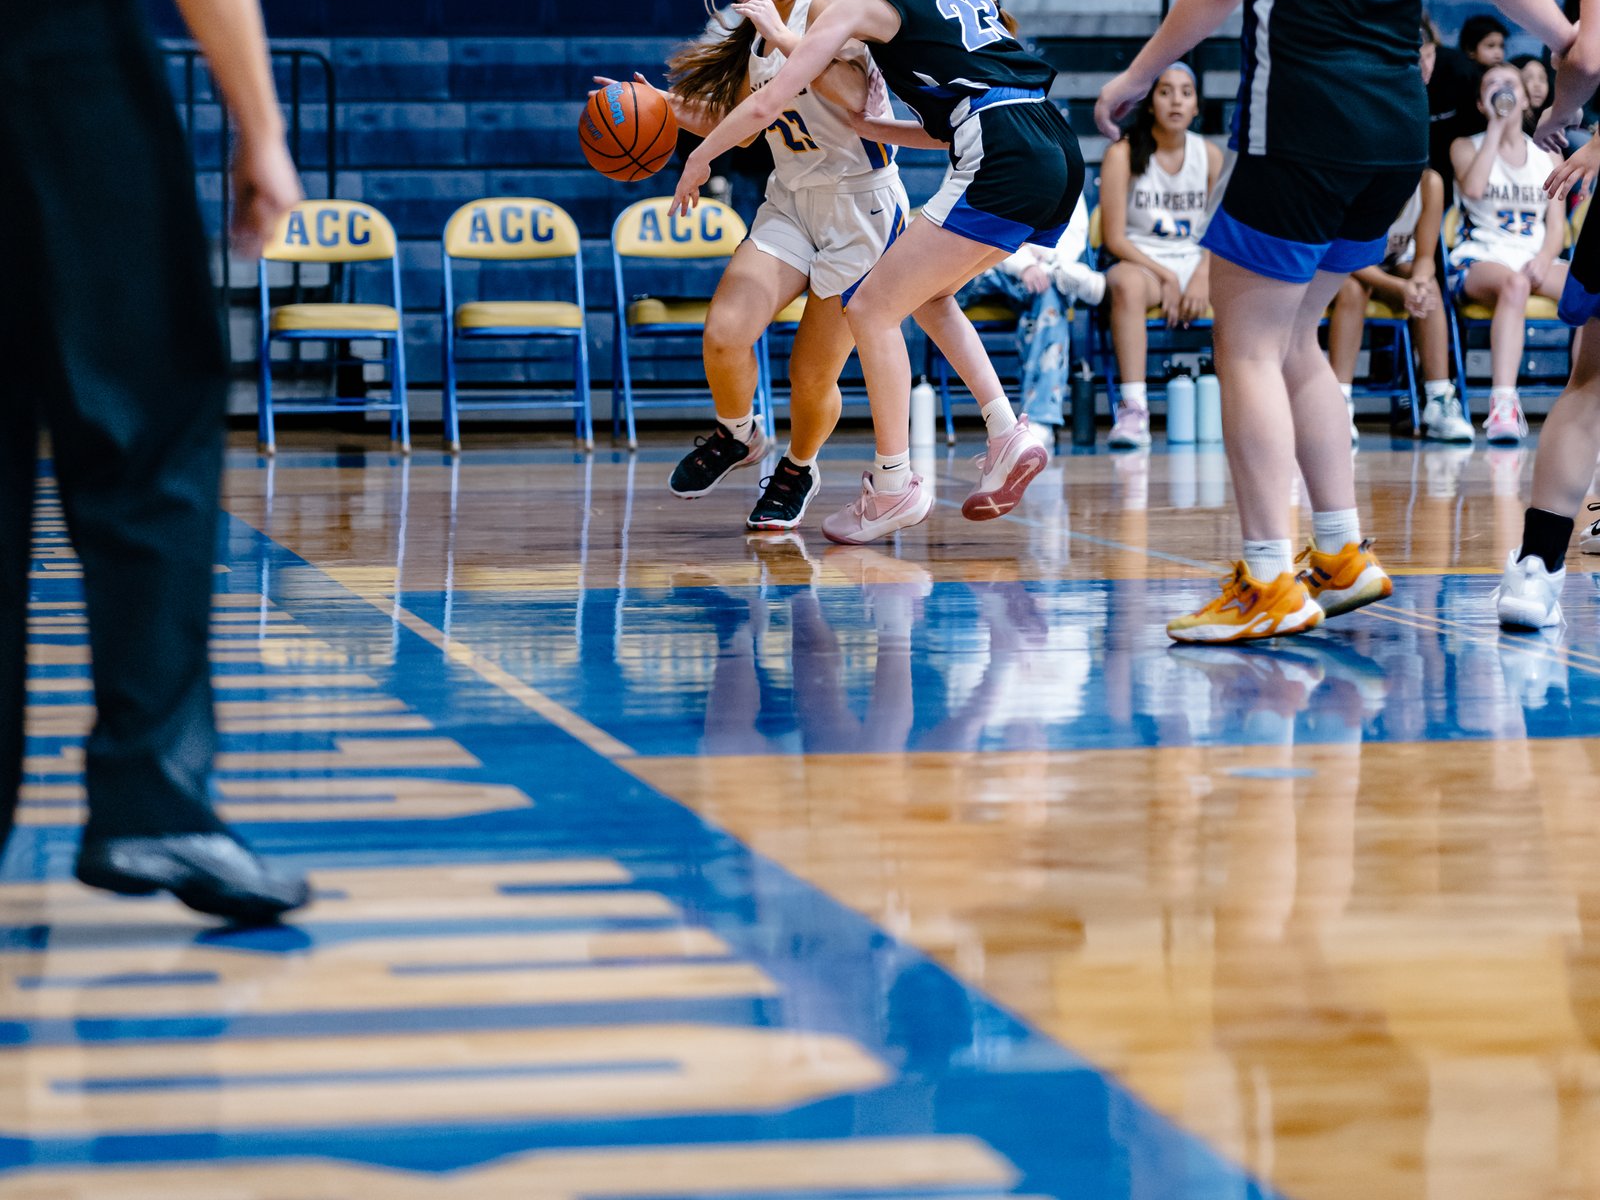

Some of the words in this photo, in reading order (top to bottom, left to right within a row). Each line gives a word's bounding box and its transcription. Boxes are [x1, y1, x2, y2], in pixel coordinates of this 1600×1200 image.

[284, 208, 372, 247] ACC
[469, 206, 555, 244] ACC
[638, 205, 724, 243] ACC
